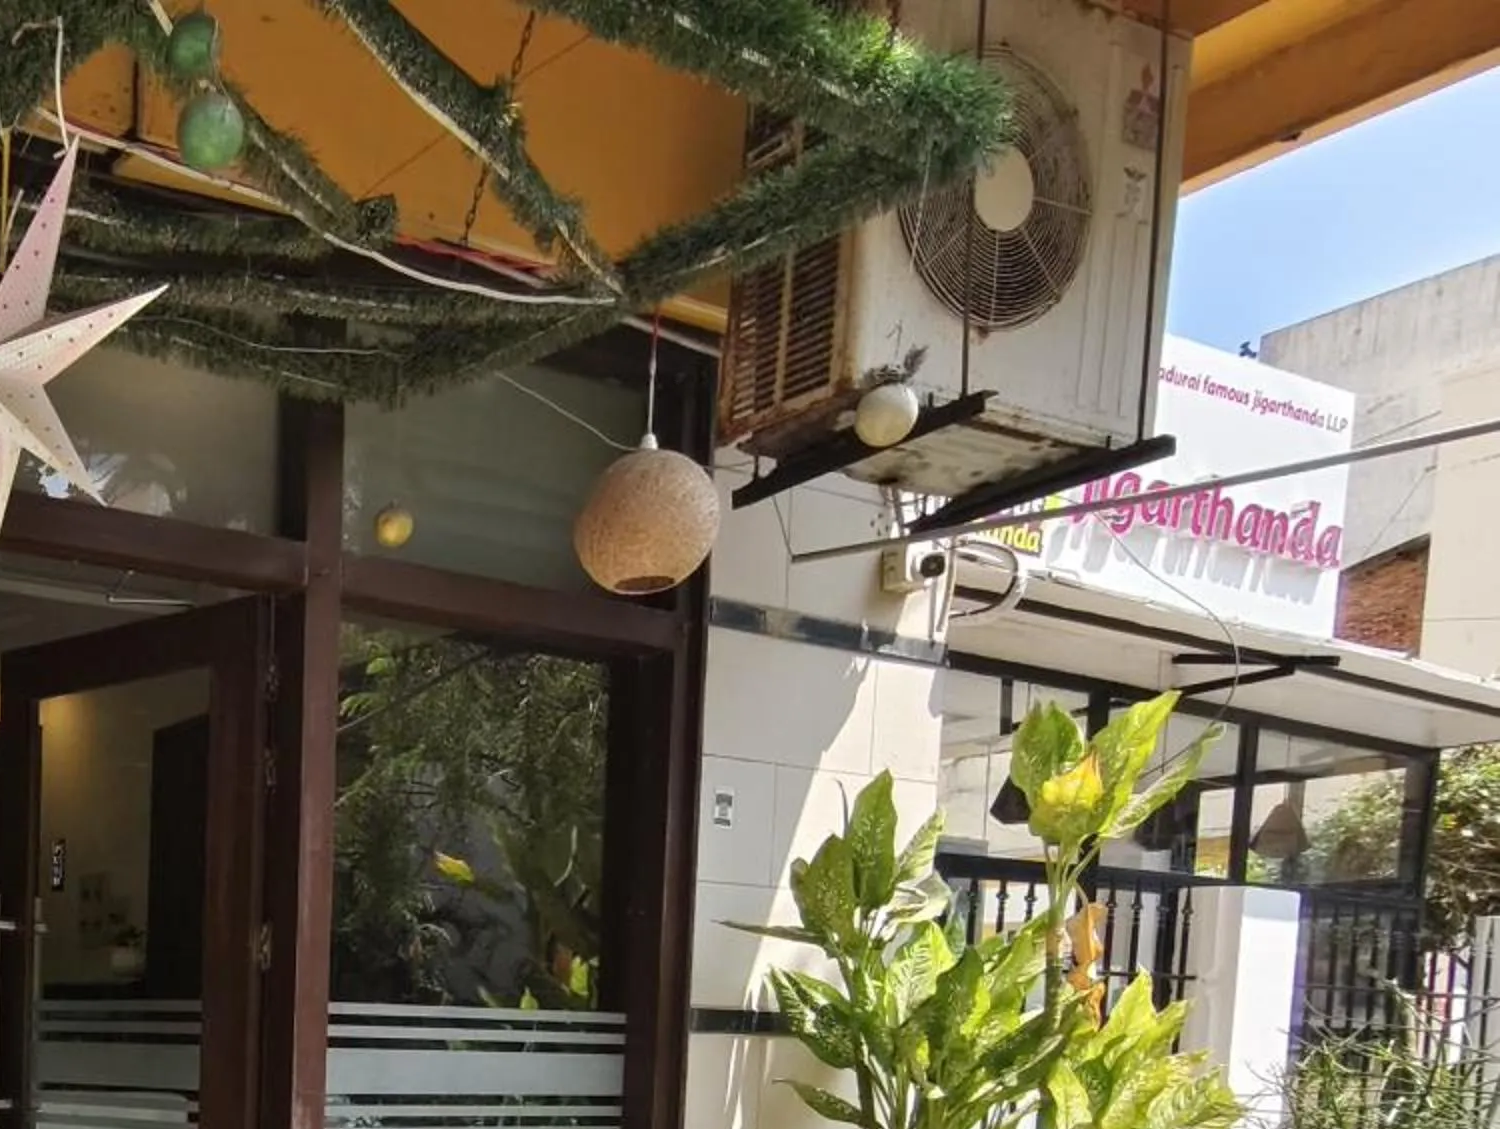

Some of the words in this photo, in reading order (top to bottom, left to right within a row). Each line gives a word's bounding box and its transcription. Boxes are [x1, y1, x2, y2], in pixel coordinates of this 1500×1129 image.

[1156, 365, 1202, 392] adurai
[1202, 374, 1251, 407] famous
[1251, 390, 1325, 428] jigarthanda
[1325, 413, 1349, 434] LLP
